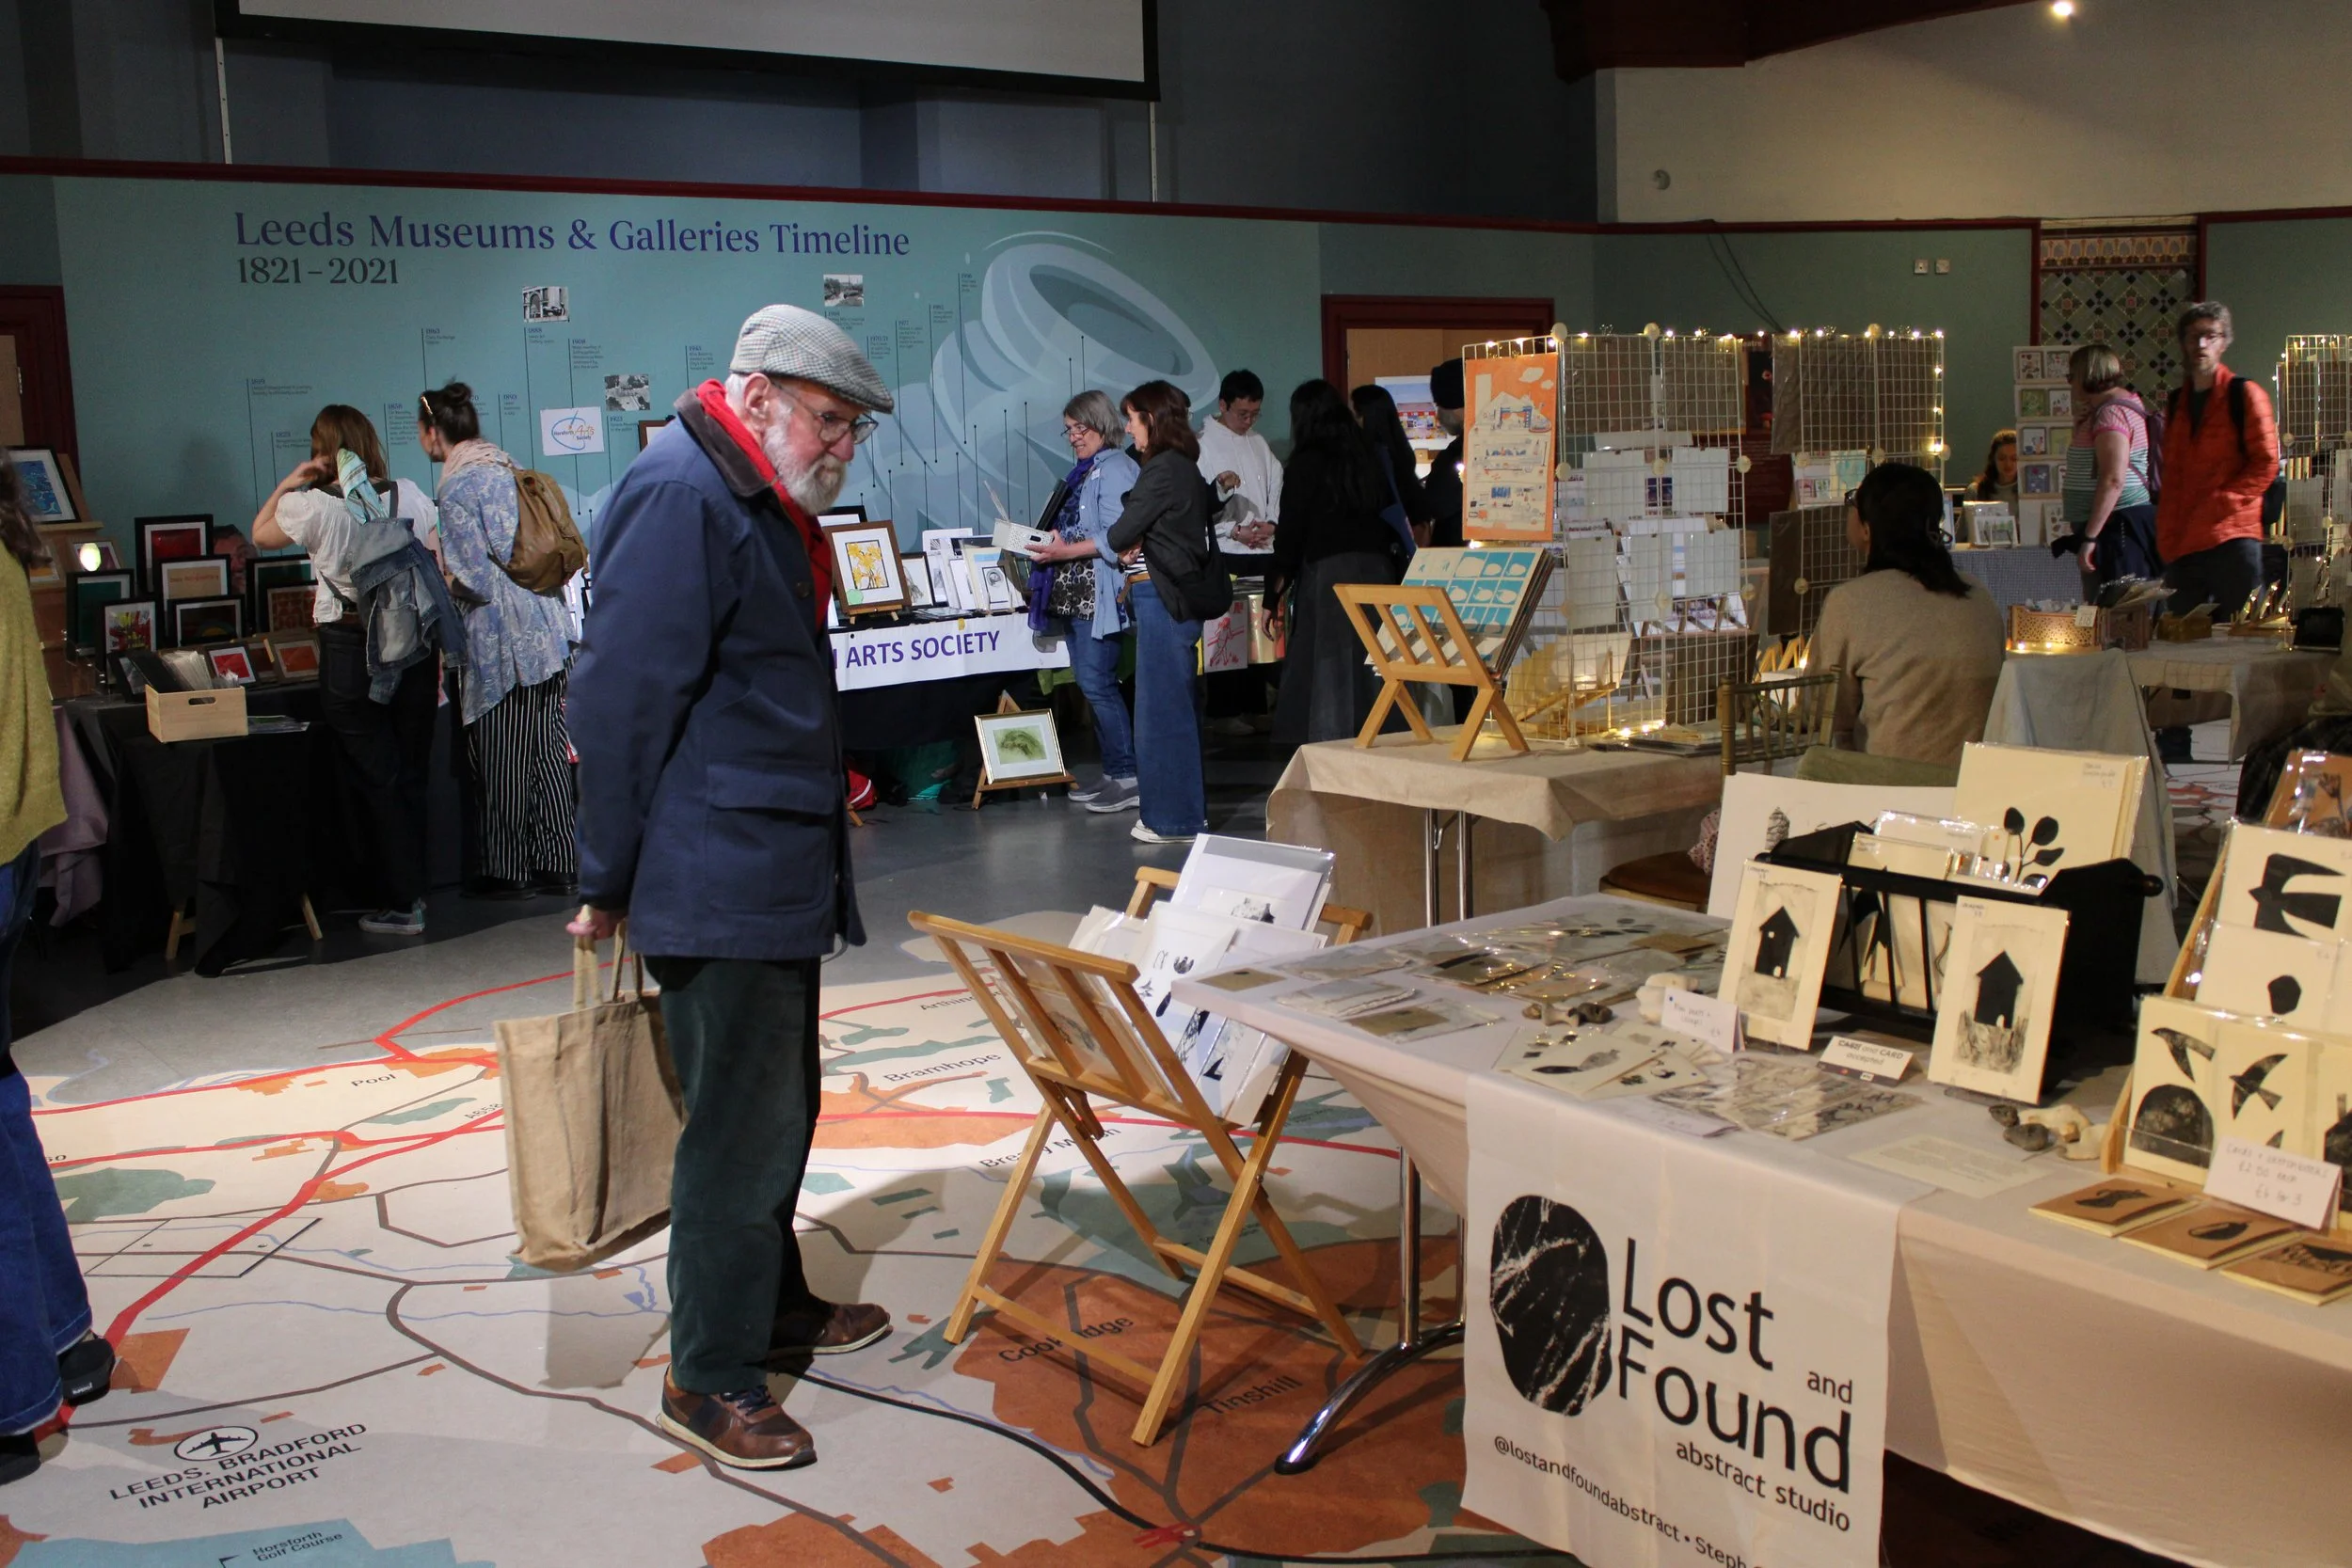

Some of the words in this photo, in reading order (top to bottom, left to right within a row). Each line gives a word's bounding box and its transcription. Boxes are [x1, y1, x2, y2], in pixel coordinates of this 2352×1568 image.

[234, 213, 355, 247] Leeds
[370, 215, 555, 250] Museums
[568, 218, 598, 250] &
[610, 219, 760, 255] Galleries
[770, 222, 911, 257] Timeline
[846, 641, 905, 669] ARTS
[911, 630, 1000, 661] SOCIETY
[882, 1053, 1002, 1083] Bramhope
[1879, 1049, 1904, 1060] CARD
[351, 1073, 397, 1087] Pool
[1622, 1237, 1774, 1372] Lost
[1198, 1375, 1303, 1414] Tinshill
[1806, 1370, 1853, 1405] and
[1618, 1323, 1852, 1495] Found
[217, 1423, 367, 1471] BRADFORD
[138, 1442, 362, 1509] INTERNATIONAL
[202, 1466, 320, 1509] AIRPORT
[1675, 1439, 1767, 1499] abstract
[1775, 1481, 1851, 1533] studio
[1494, 1435, 1681, 1543] @lostandfoundabstract
[1695, 1535, 1746, 1568] Steph
[252, 1530, 324, 1556] Horsforth
[257, 1547, 288, 1562] Golf
[291, 1533, 343, 1552] Course
